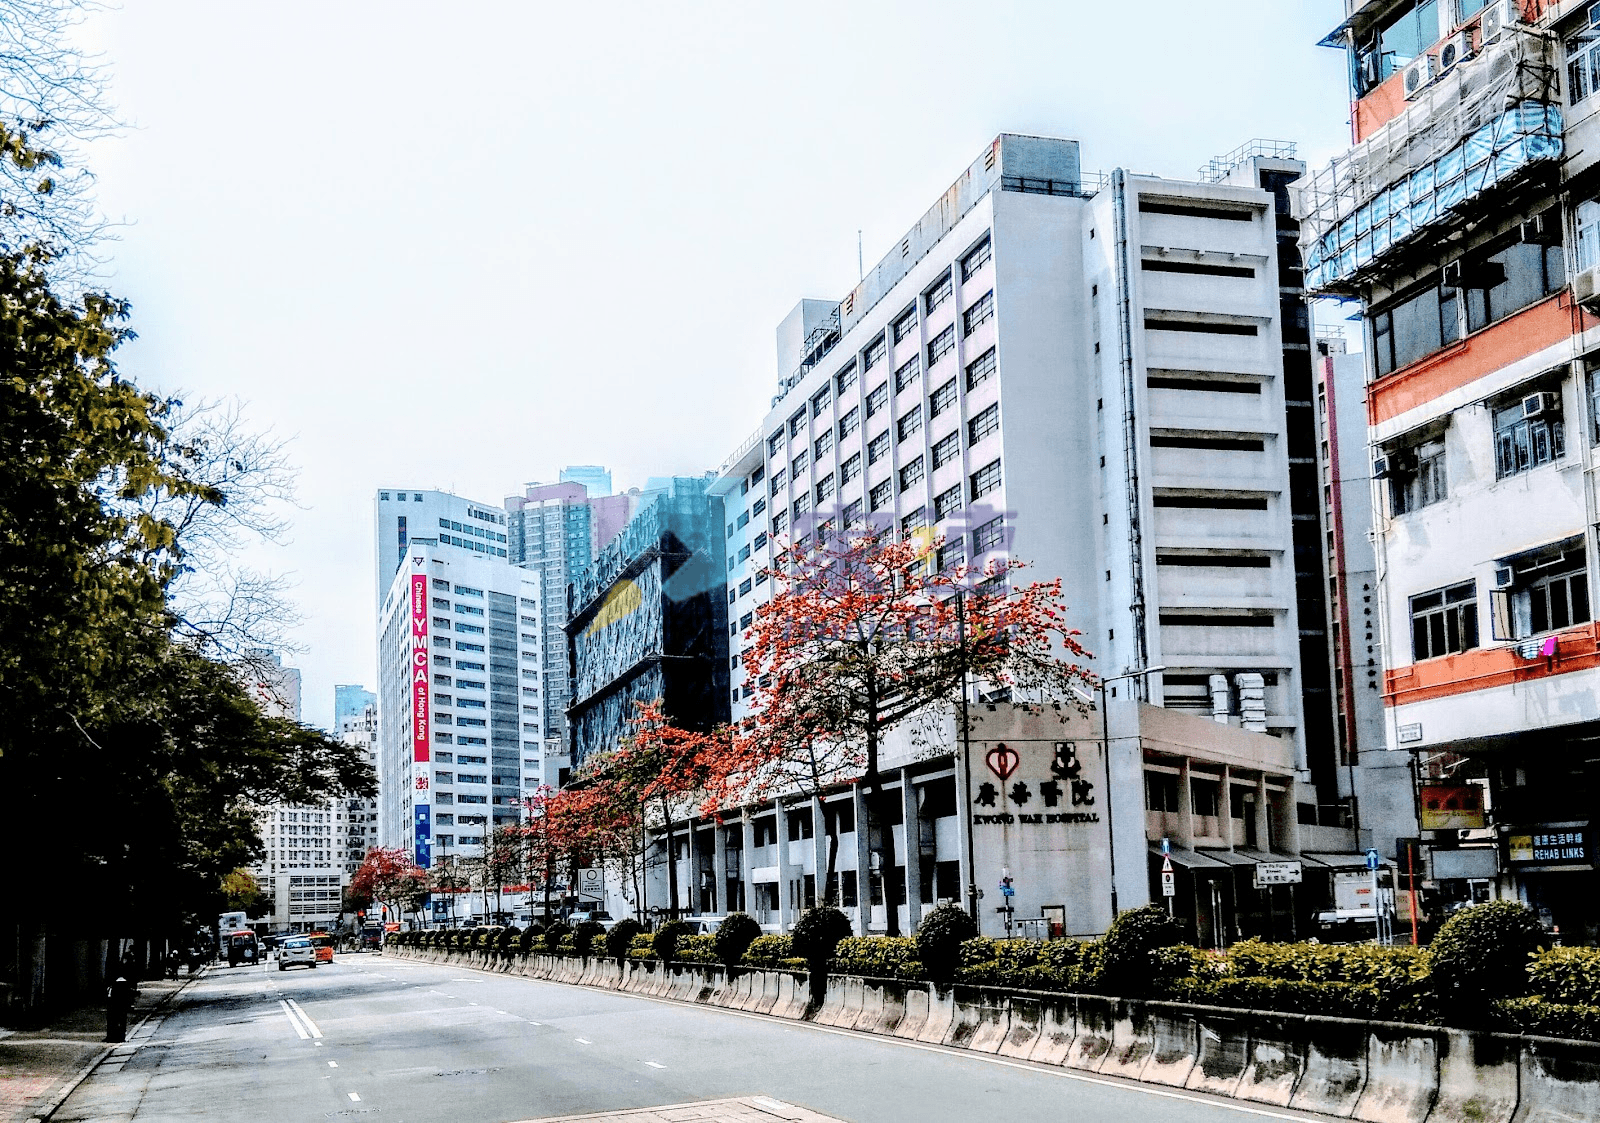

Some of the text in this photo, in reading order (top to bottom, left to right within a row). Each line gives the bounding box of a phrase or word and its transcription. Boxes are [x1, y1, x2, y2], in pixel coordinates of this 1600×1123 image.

[415, 581, 424, 614] Chinese
[413, 617, 428, 684] YMCA
[416, 697, 426, 718] Hong
[416, 719, 427, 741] Kong
[1534, 847, 1584, 860] REHAB LINKS
